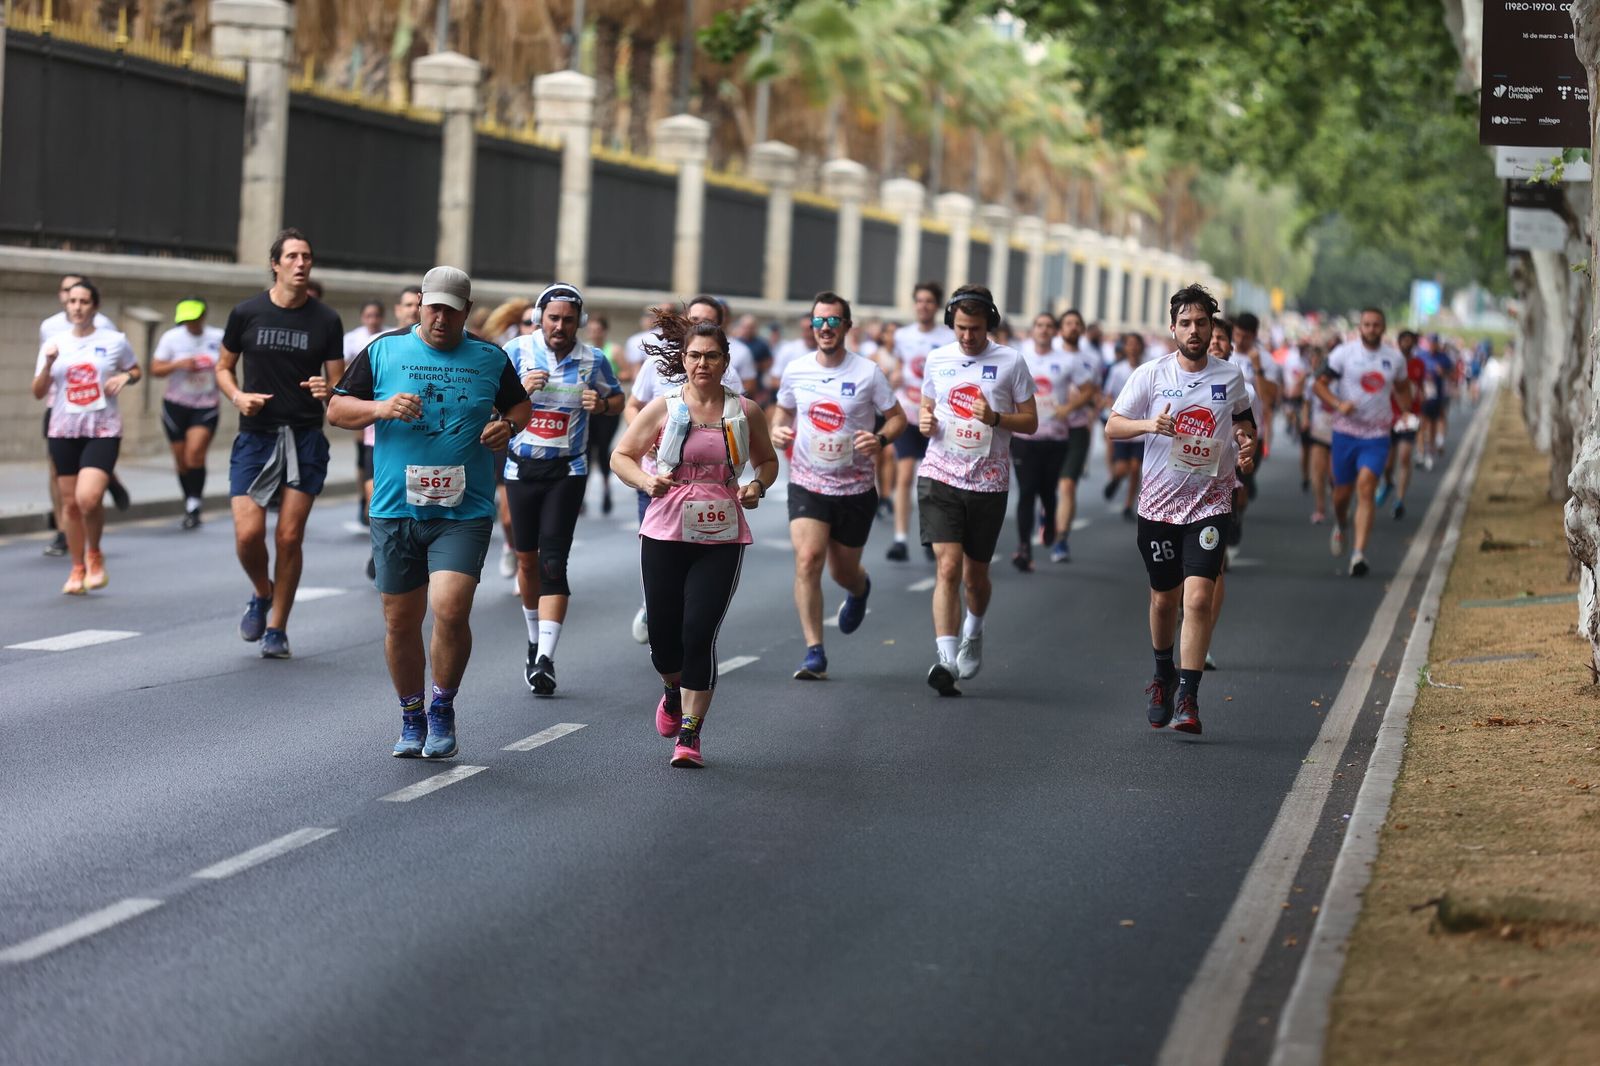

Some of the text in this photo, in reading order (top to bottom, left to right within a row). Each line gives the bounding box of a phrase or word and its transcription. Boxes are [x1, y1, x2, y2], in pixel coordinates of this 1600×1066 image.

[1505, 2, 1572, 11] (1920-1970). CO
[1508, 85, 1543, 93] Fundación
[1574, 86, 1588, 94] Fun
[1508, 92, 1533, 100] Unicaja
[256, 329, 309, 350] FITCLUB
[455, 367, 480, 375] FONDO
[954, 391, 975, 402] PONL
[530, 417, 564, 431] 2730
[1181, 414, 1212, 431] PONLE
[956, 428, 981, 441] 584
[1178, 422, 1209, 438] FRENO
[819, 442, 843, 453] 217
[1183, 444, 1210, 457] 903
[420, 477, 452, 488] 567
[697, 510, 726, 523] 196
[1150, 540, 1175, 562] 26
